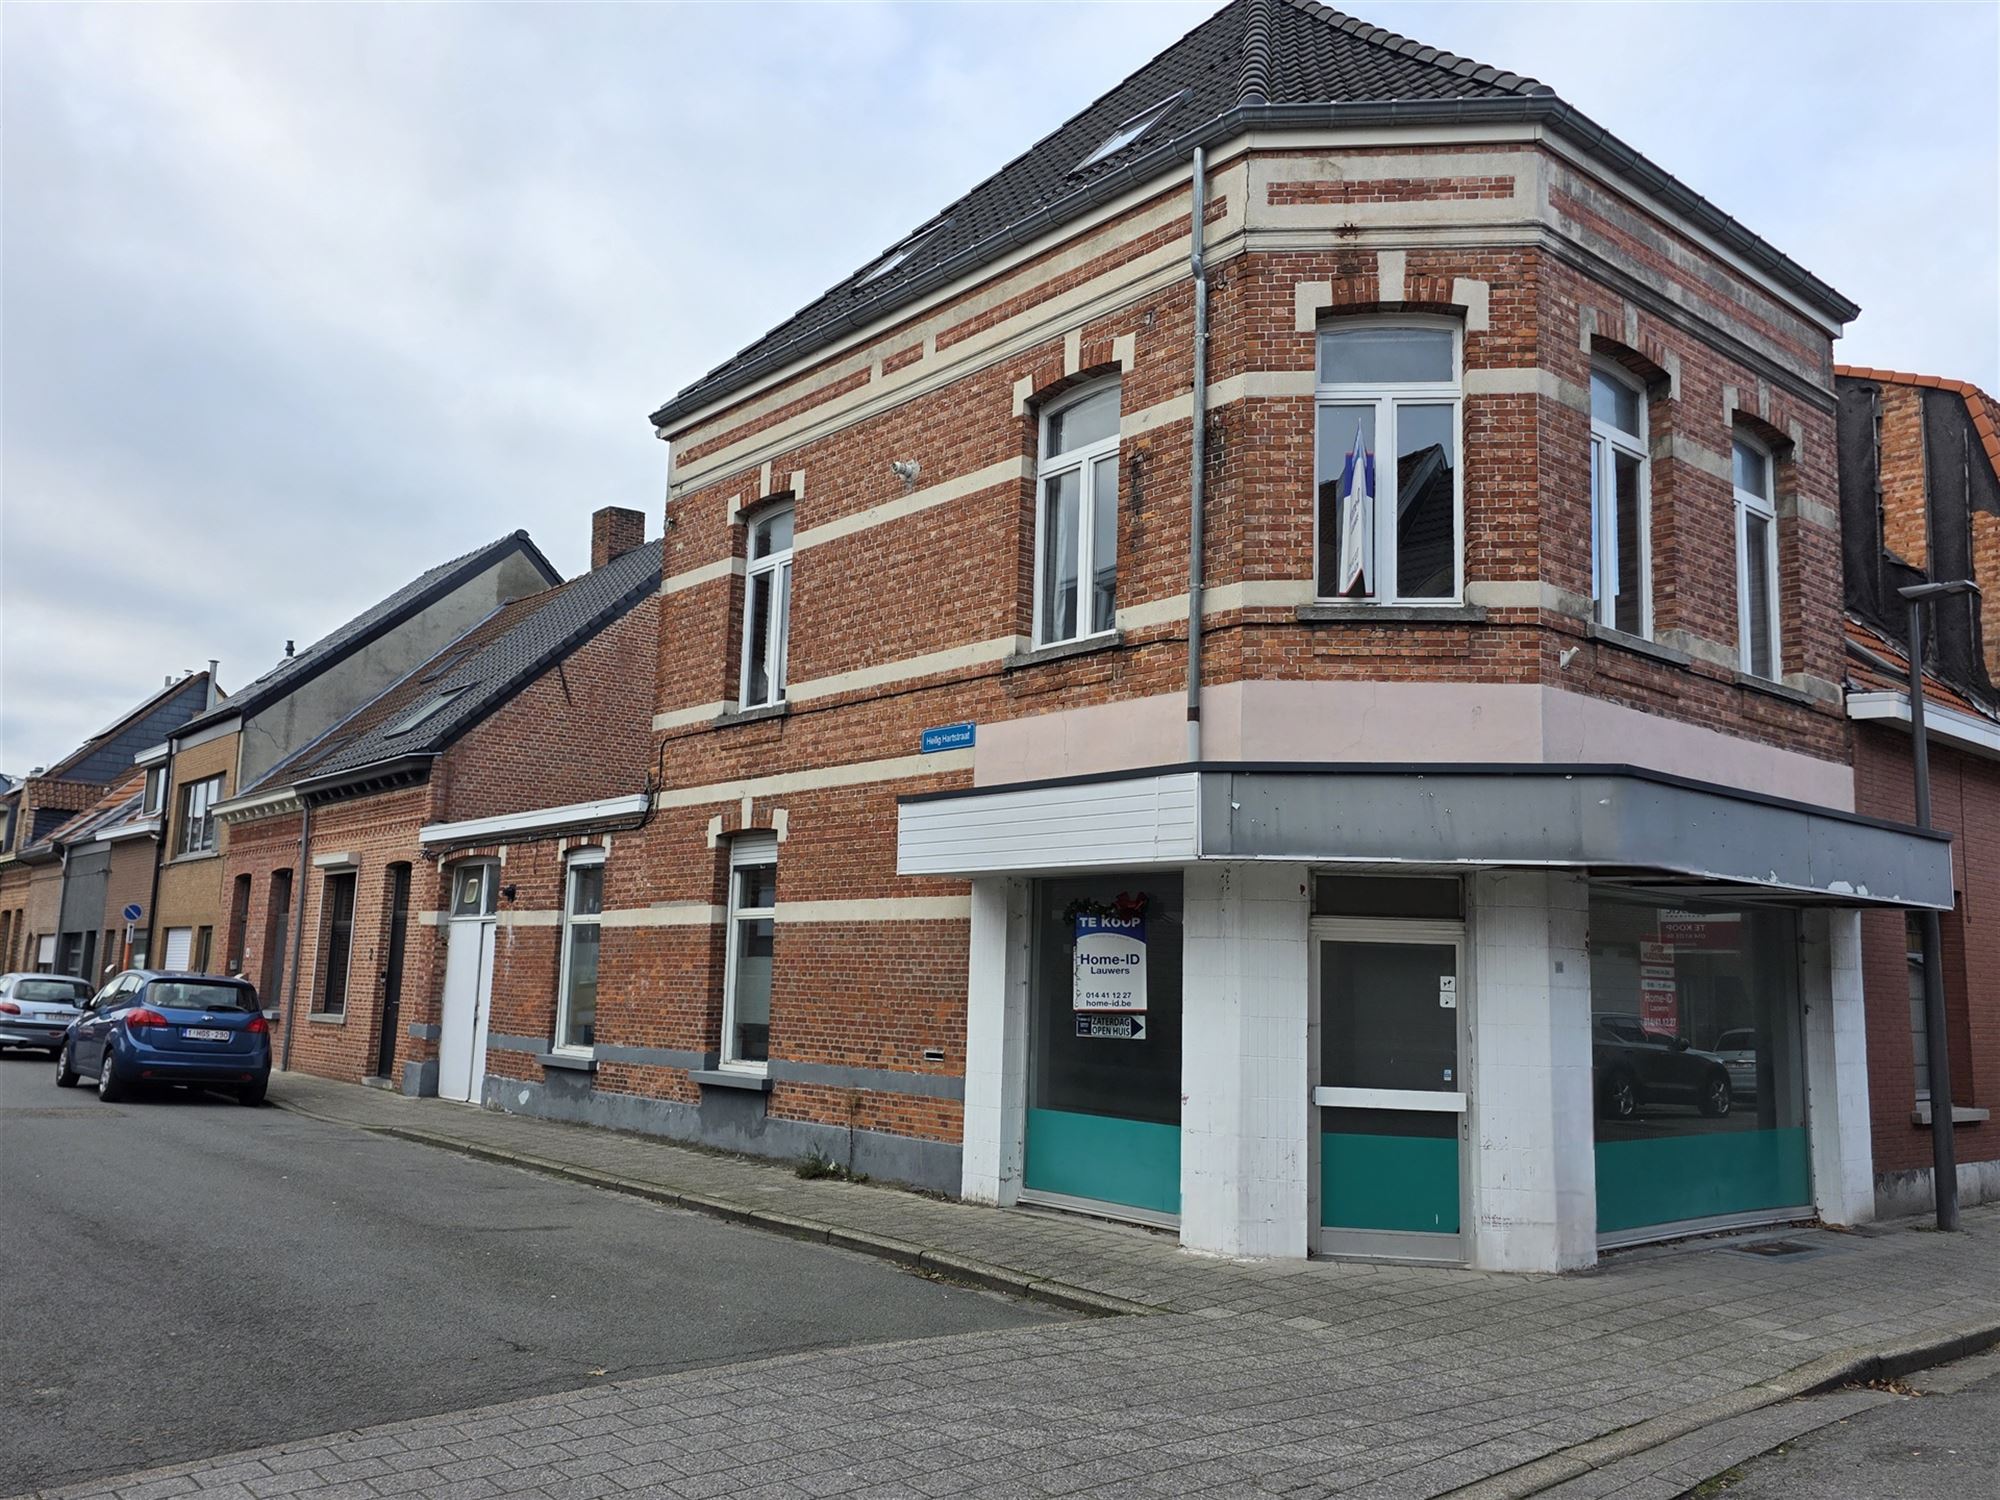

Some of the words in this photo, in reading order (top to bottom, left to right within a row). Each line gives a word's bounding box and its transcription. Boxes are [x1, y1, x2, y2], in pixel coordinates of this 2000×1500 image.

[926, 735, 941, 746] Heilig
[942, 731, 970, 743] Hartstraat
[1079, 917, 1097, 928] TE
[1101, 917, 1142, 928] KOOP
[1080, 953, 1140, 965] Home-ID
[1090, 966, 1130, 975] Lauwers
[1085, 999, 1132, 1007] home-id.be
[1092, 1016, 1130, 1027] ZATERDAG
[1092, 1026, 1111, 1035] OPEN
[1113, 1027, 1130, 1036] HUIS
